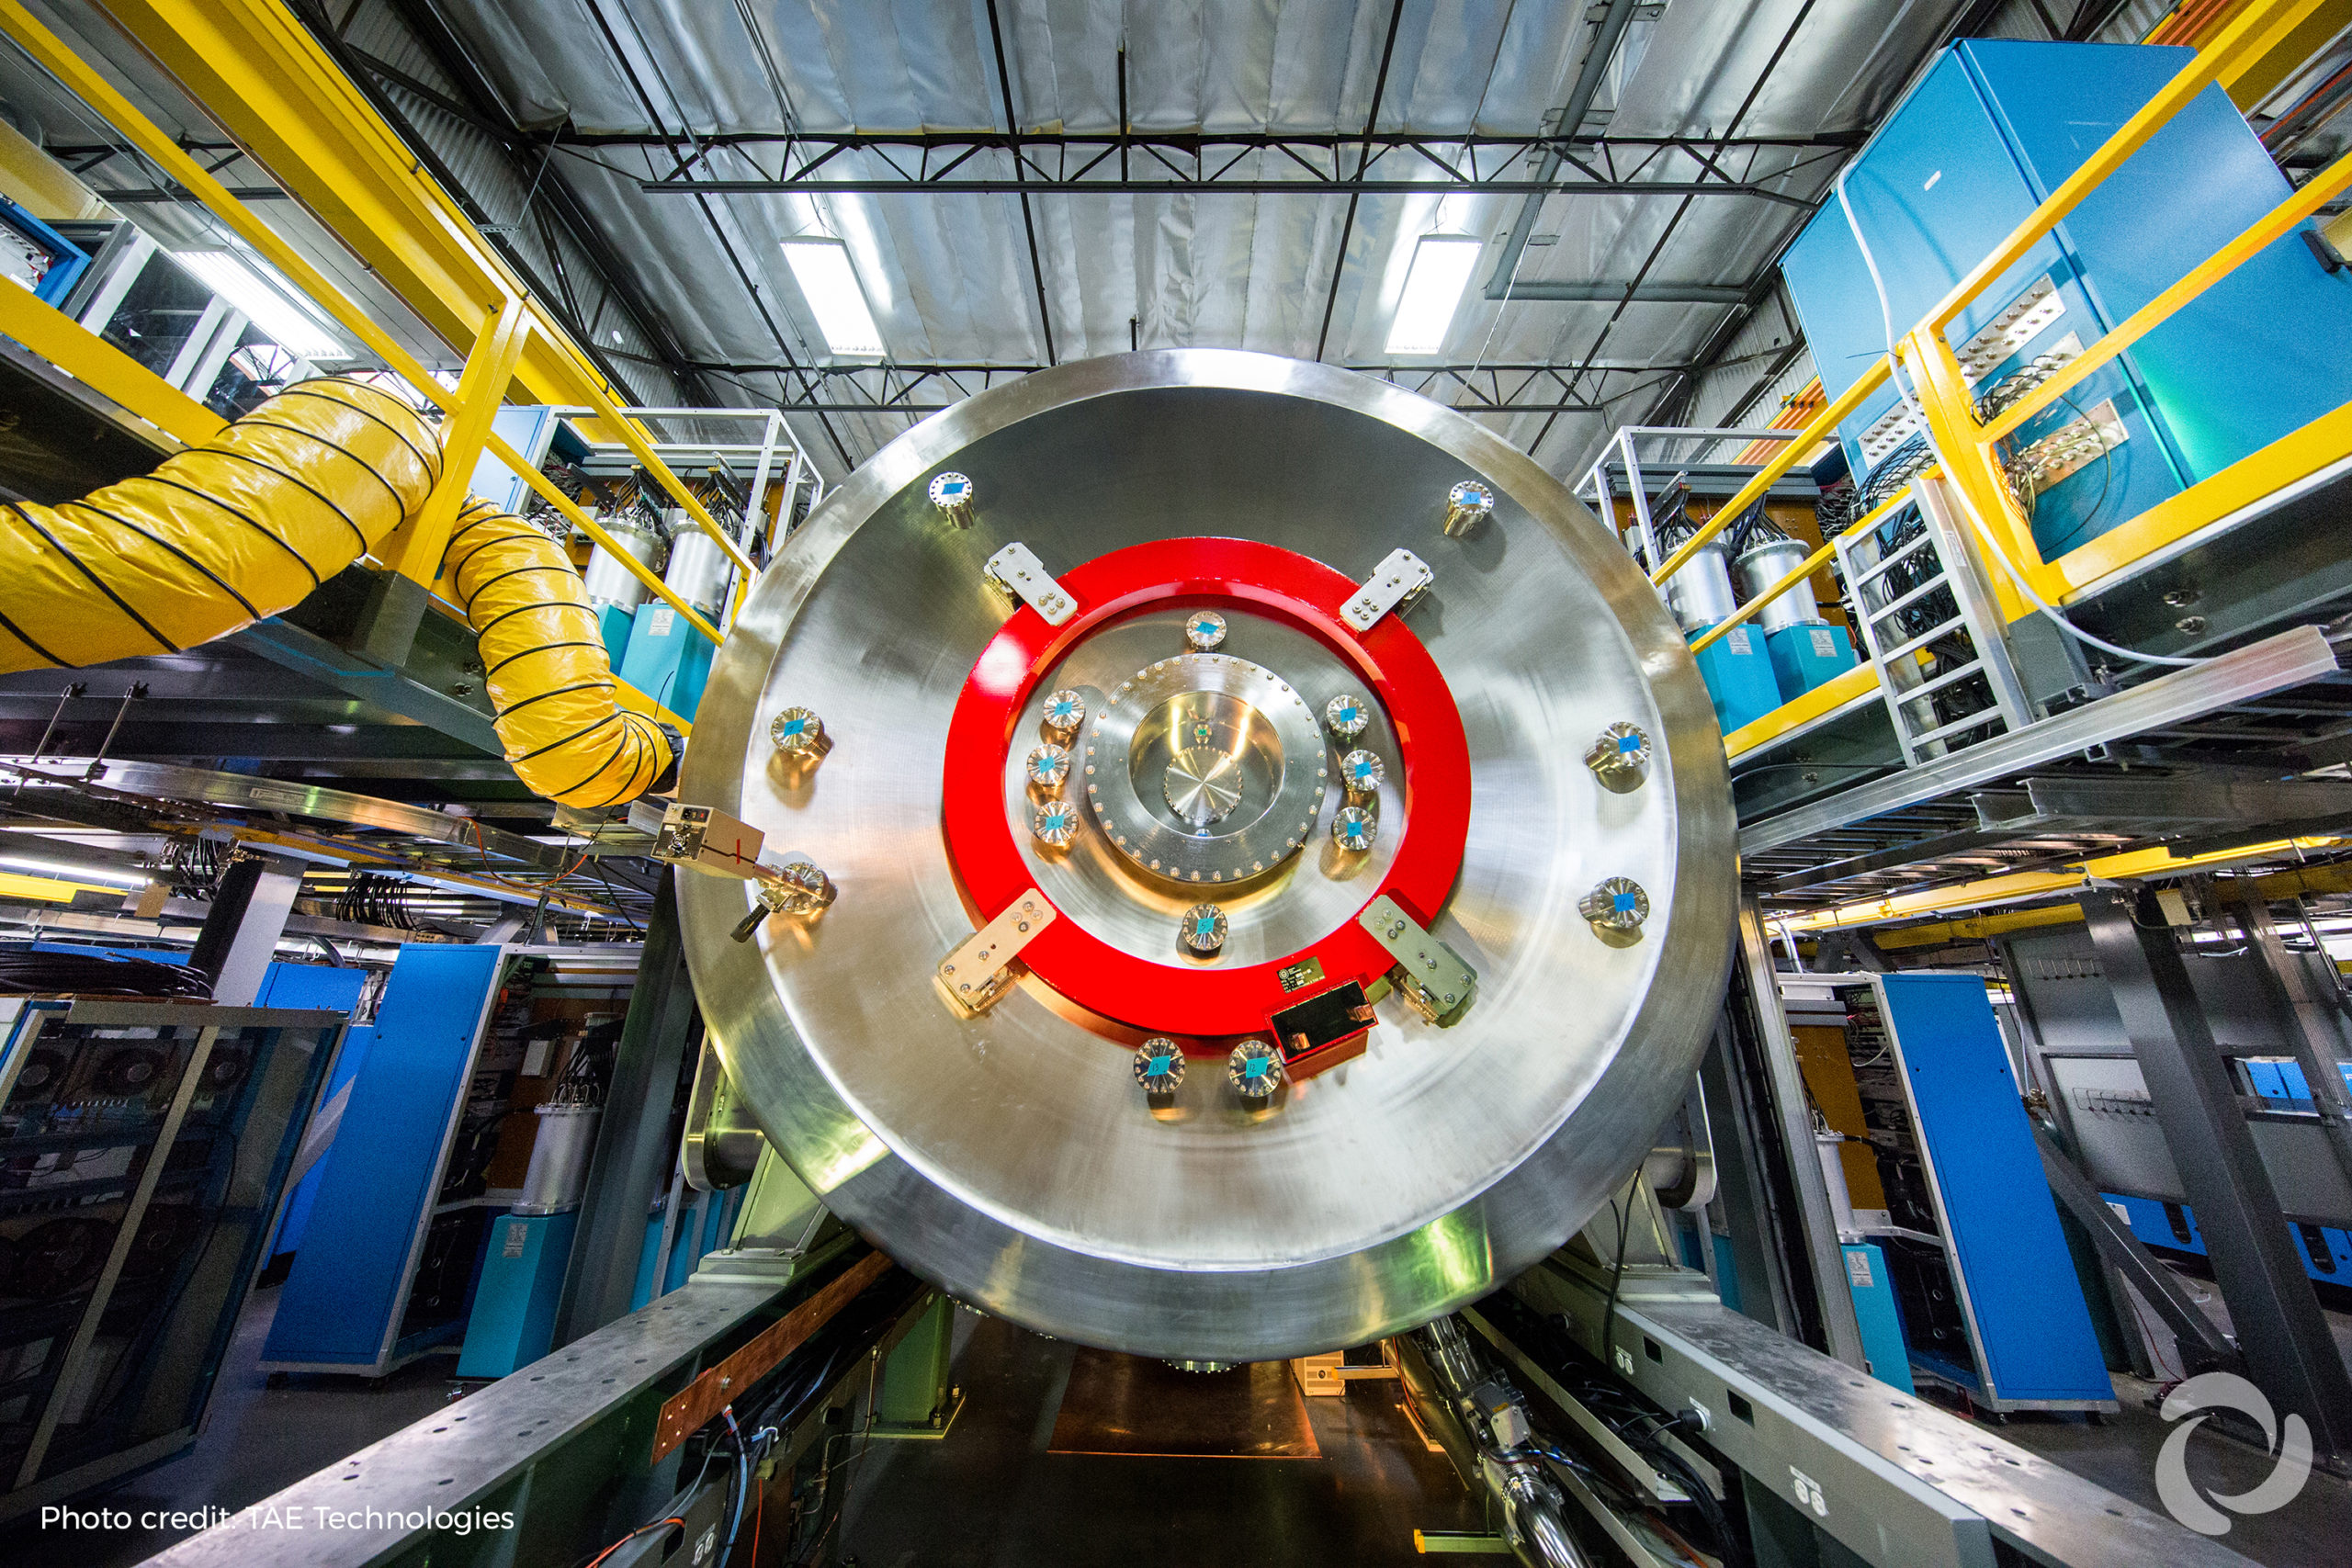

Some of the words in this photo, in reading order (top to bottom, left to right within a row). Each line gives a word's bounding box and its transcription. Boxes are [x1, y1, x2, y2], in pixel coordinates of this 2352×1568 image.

[1200, 920, 1208, 931] 5
[1152, 1064, 1159, 1072] 13
[1249, 1064, 1256, 1073] 12
